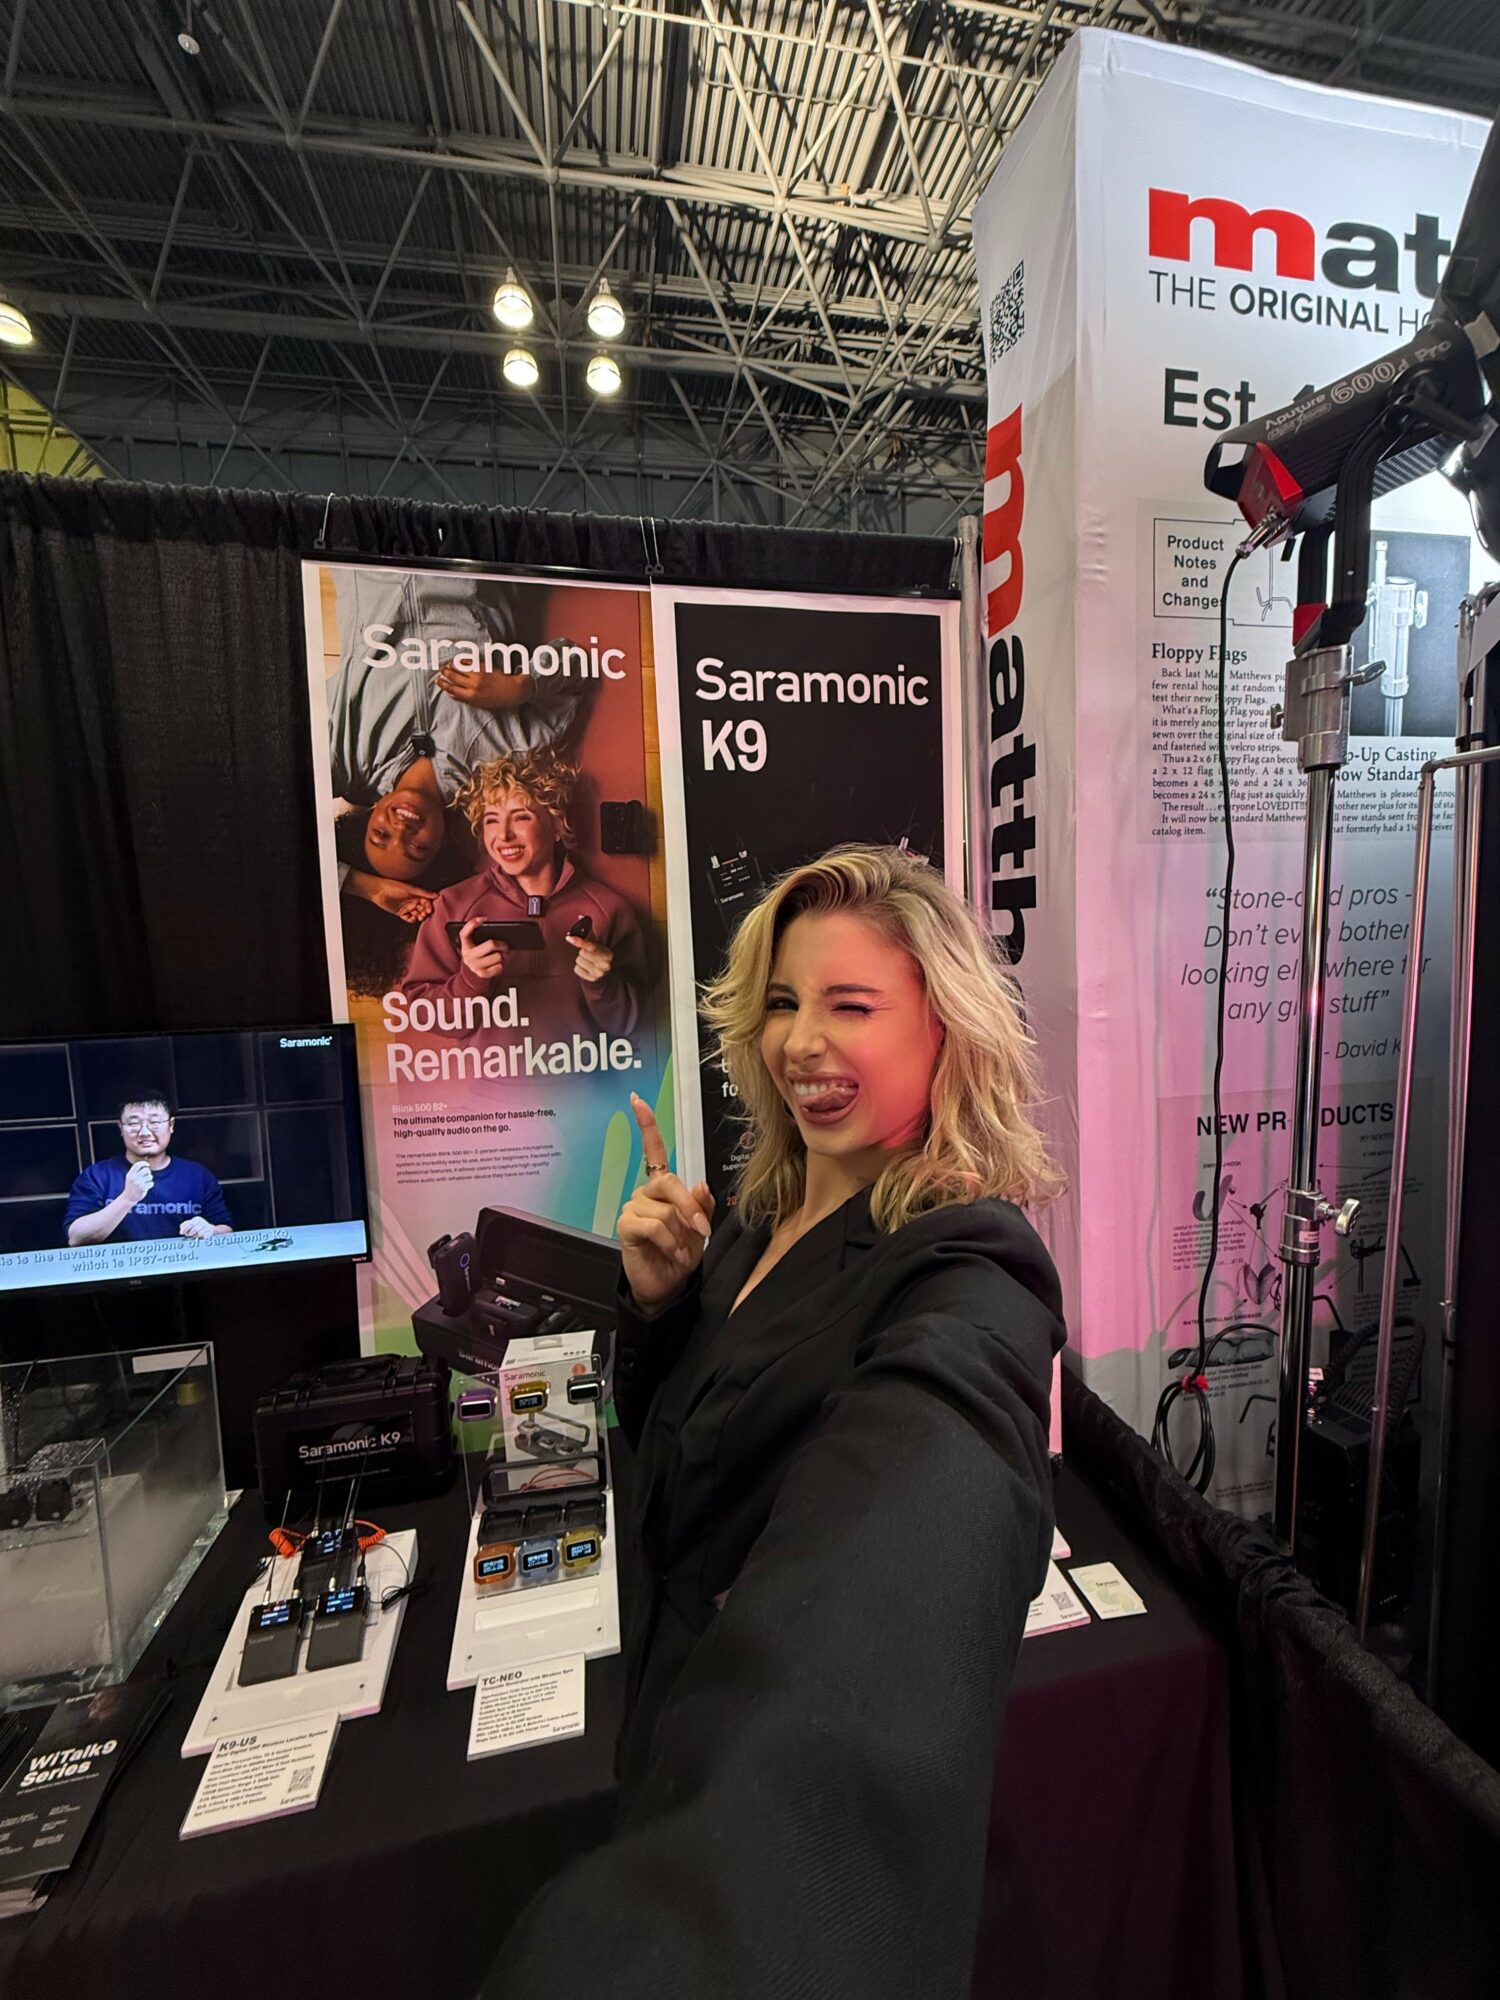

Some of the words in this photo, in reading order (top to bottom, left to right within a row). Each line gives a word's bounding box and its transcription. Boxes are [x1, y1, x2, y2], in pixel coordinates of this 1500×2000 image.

[1149, 270, 1216, 310] THE
[1230, 283, 1388, 333] ORIGINAL
[1265, 395, 1326, 431] Aputure
[1414, 341, 1451, 361] Pro
[1168, 535, 1224, 551] Product
[1174, 555, 1216, 569] Notes
[1182, 576, 1208, 588] and
[362, 623, 626, 679] Saramonic
[1152, 643, 1203, 663] Floppy
[1210, 645, 1247, 665] Fags
[1162, 668, 1182, 677] Back
[1186, 669, 1200, 678] last
[1230, 671, 1272, 680] Matthews
[696, 658, 929, 705] Saramonic
[1152, 680, 1169, 689] few
[1173, 681, 1198, 690] rental
[1243, 684, 1274, 692] random
[1153, 694, 1168, 702] test
[1171, 694, 1191, 702] their
[1245, 695, 1268, 705] Flags.
[1163, 705, 1191, 715] What's
[1230, 706, 1246, 717] Flag
[1249, 709, 1264, 718] you
[1153, 718, 1158, 726] it
[1161, 718, 1167, 726] is
[1170, 718, 1199, 728] merely
[1202, 718, 1235, 728] anoer
[1237, 720, 1257, 729] layer
[1260, 719, 1268, 728] of
[1199, 731, 1212, 739] the
[1250, 732, 1264, 740] size
[1267, 732, 1275, 740] of
[702, 719, 767, 772] K9
[1153, 742, 1168, 751] and
[1171, 743, 1206, 751] fastened
[1231, 743, 1255, 751] velcro
[1258, 744, 1282, 753] strips.
[1163, 754, 1184, 763] Thus
[1206, 755, 1212, 763] 6
[1243, 754, 1260, 764] Flag
[1163, 767, 1168, 775] 2
[1184, 767, 1192, 775] 12
[1198, 767, 1213, 776] flag
[1274, 768, 1284, 776] 48
[1153, 779, 1188, 787] becomes
[1204, 779, 1214, 787] 48
[1230, 779, 1239, 787] 96
[1274, 779, 1282, 787] 24
[1153, 791, 1189, 799] becomes
[1198, 791, 1208, 799] 24
[1231, 790, 1246, 800] flag
[1248, 790, 1262, 800] just
[1276, 790, 1307, 801] quickly.
[1338, 790, 1376, 798] Matthews
[1163, 802, 1178, 811] The
[1257, 802, 1289, 810] LOVED
[1378, 802, 1394, 811] plus
[1396, 801, 1406, 809] for
[1162, 815, 1168, 823] It
[1171, 815, 1186, 823] will
[1210, 815, 1218, 823] be
[1232, 814, 1263, 822] tandard
[1152, 827, 1182, 836] catalog
[1184, 827, 1205, 835] item.
[1347, 825, 1380, 834] formerly
[1383, 824, 1396, 832] had
[1206, 885, 1344, 910] “Stone-cd
[1349, 886, 1397, 910] pros
[1339, 920, 1410, 942] bother
[1181, 964, 1269, 987] looking
[1277, 956, 1394, 981] elwhere
[1401, 955, 1431, 974] fr
[382, 987, 529, 1033] Sound.
[1228, 1001, 1271, 1023] any
[1336, 1040, 1387, 1059] David
[386, 1033, 641, 1083] Remarkable.
[392, 1105, 414, 1113] Blink
[416, 1104, 431, 1112] 500
[393, 1117, 408, 1126] The
[410, 1114, 445, 1125] ultimate
[446, 1112, 494, 1123] companion
[496, 1112, 506, 1120] for
[508, 1109, 556, 1118] hassle-free,
[1197, 1114, 1250, 1136] NEW
[1257, 1103, 1393, 1132] PRDUCTS
[394, 1126, 445, 1139] high-quality
[447, 1126, 470, 1135] audio
[484, 1125, 496, 1133] the
[498, 1126, 511, 1134] go.
[34, 1253, 53, 1263] the
[59, 1247, 106, 1260] lavalier
[110, 1241, 184, 1257] microphone
[72, 1259, 109, 1272] which
[113, 1258, 124, 1268] is
[504, 1370, 546, 1382] Saramonic
[299, 1436, 376, 1458] Saramonic
[380, 1432, 400, 1446] K9
[482, 1671, 522, 1686] TC-NEO
[219, 1736, 257, 1752] K9-US
[29, 1739, 118, 1772] WiTalk9
[20, 1761, 92, 1787] Series
